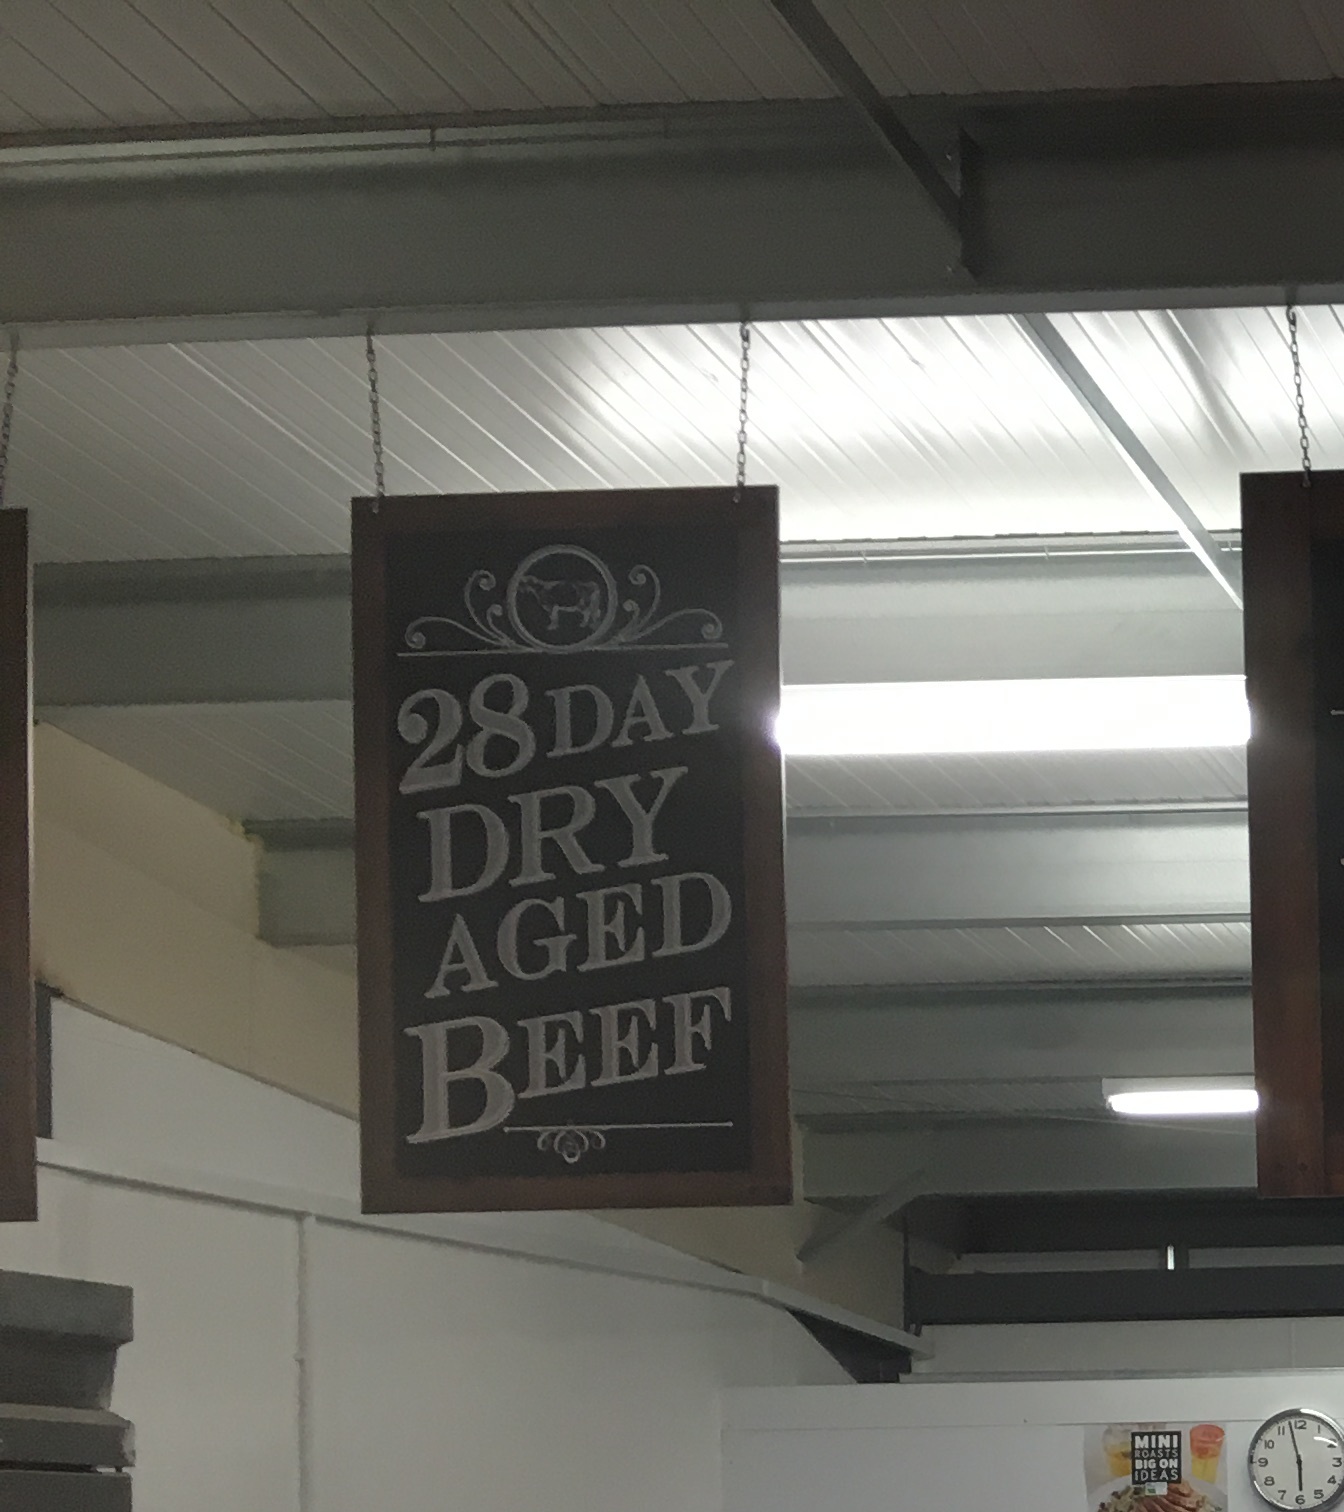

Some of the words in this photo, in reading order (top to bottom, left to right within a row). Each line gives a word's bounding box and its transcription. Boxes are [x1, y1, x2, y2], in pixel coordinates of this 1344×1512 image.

[398, 673, 537, 795] 28
[545, 660, 735, 759] DAY
[416, 765, 689, 902] DRY
[424, 871, 733, 999] AGED
[404, 986, 732, 1144] BEEF
[1294, 1420, 1307, 1430] 12
[1134, 1434, 1179, 1449] MINI
[1264, 1440, 1275, 1449] 10
[1134, 1449, 1179, 1458] ROASTS
[1135, 1459, 1157, 1470] BIG
[1159, 1458, 1179, 1469] ON
[1258, 1457, 1269, 1467] 9
[1332, 1457, 1343, 1467] 3
[1134, 1469, 1179, 1481] IDEAS
[1327, 1475, 1337, 1485] 4
[1263, 1476, 1275, 1486] 8
[1278, 1490, 1287, 1500] 7
[1313, 1489, 1324, 1499] 5
[1295, 1495, 1306, 1505] 6
